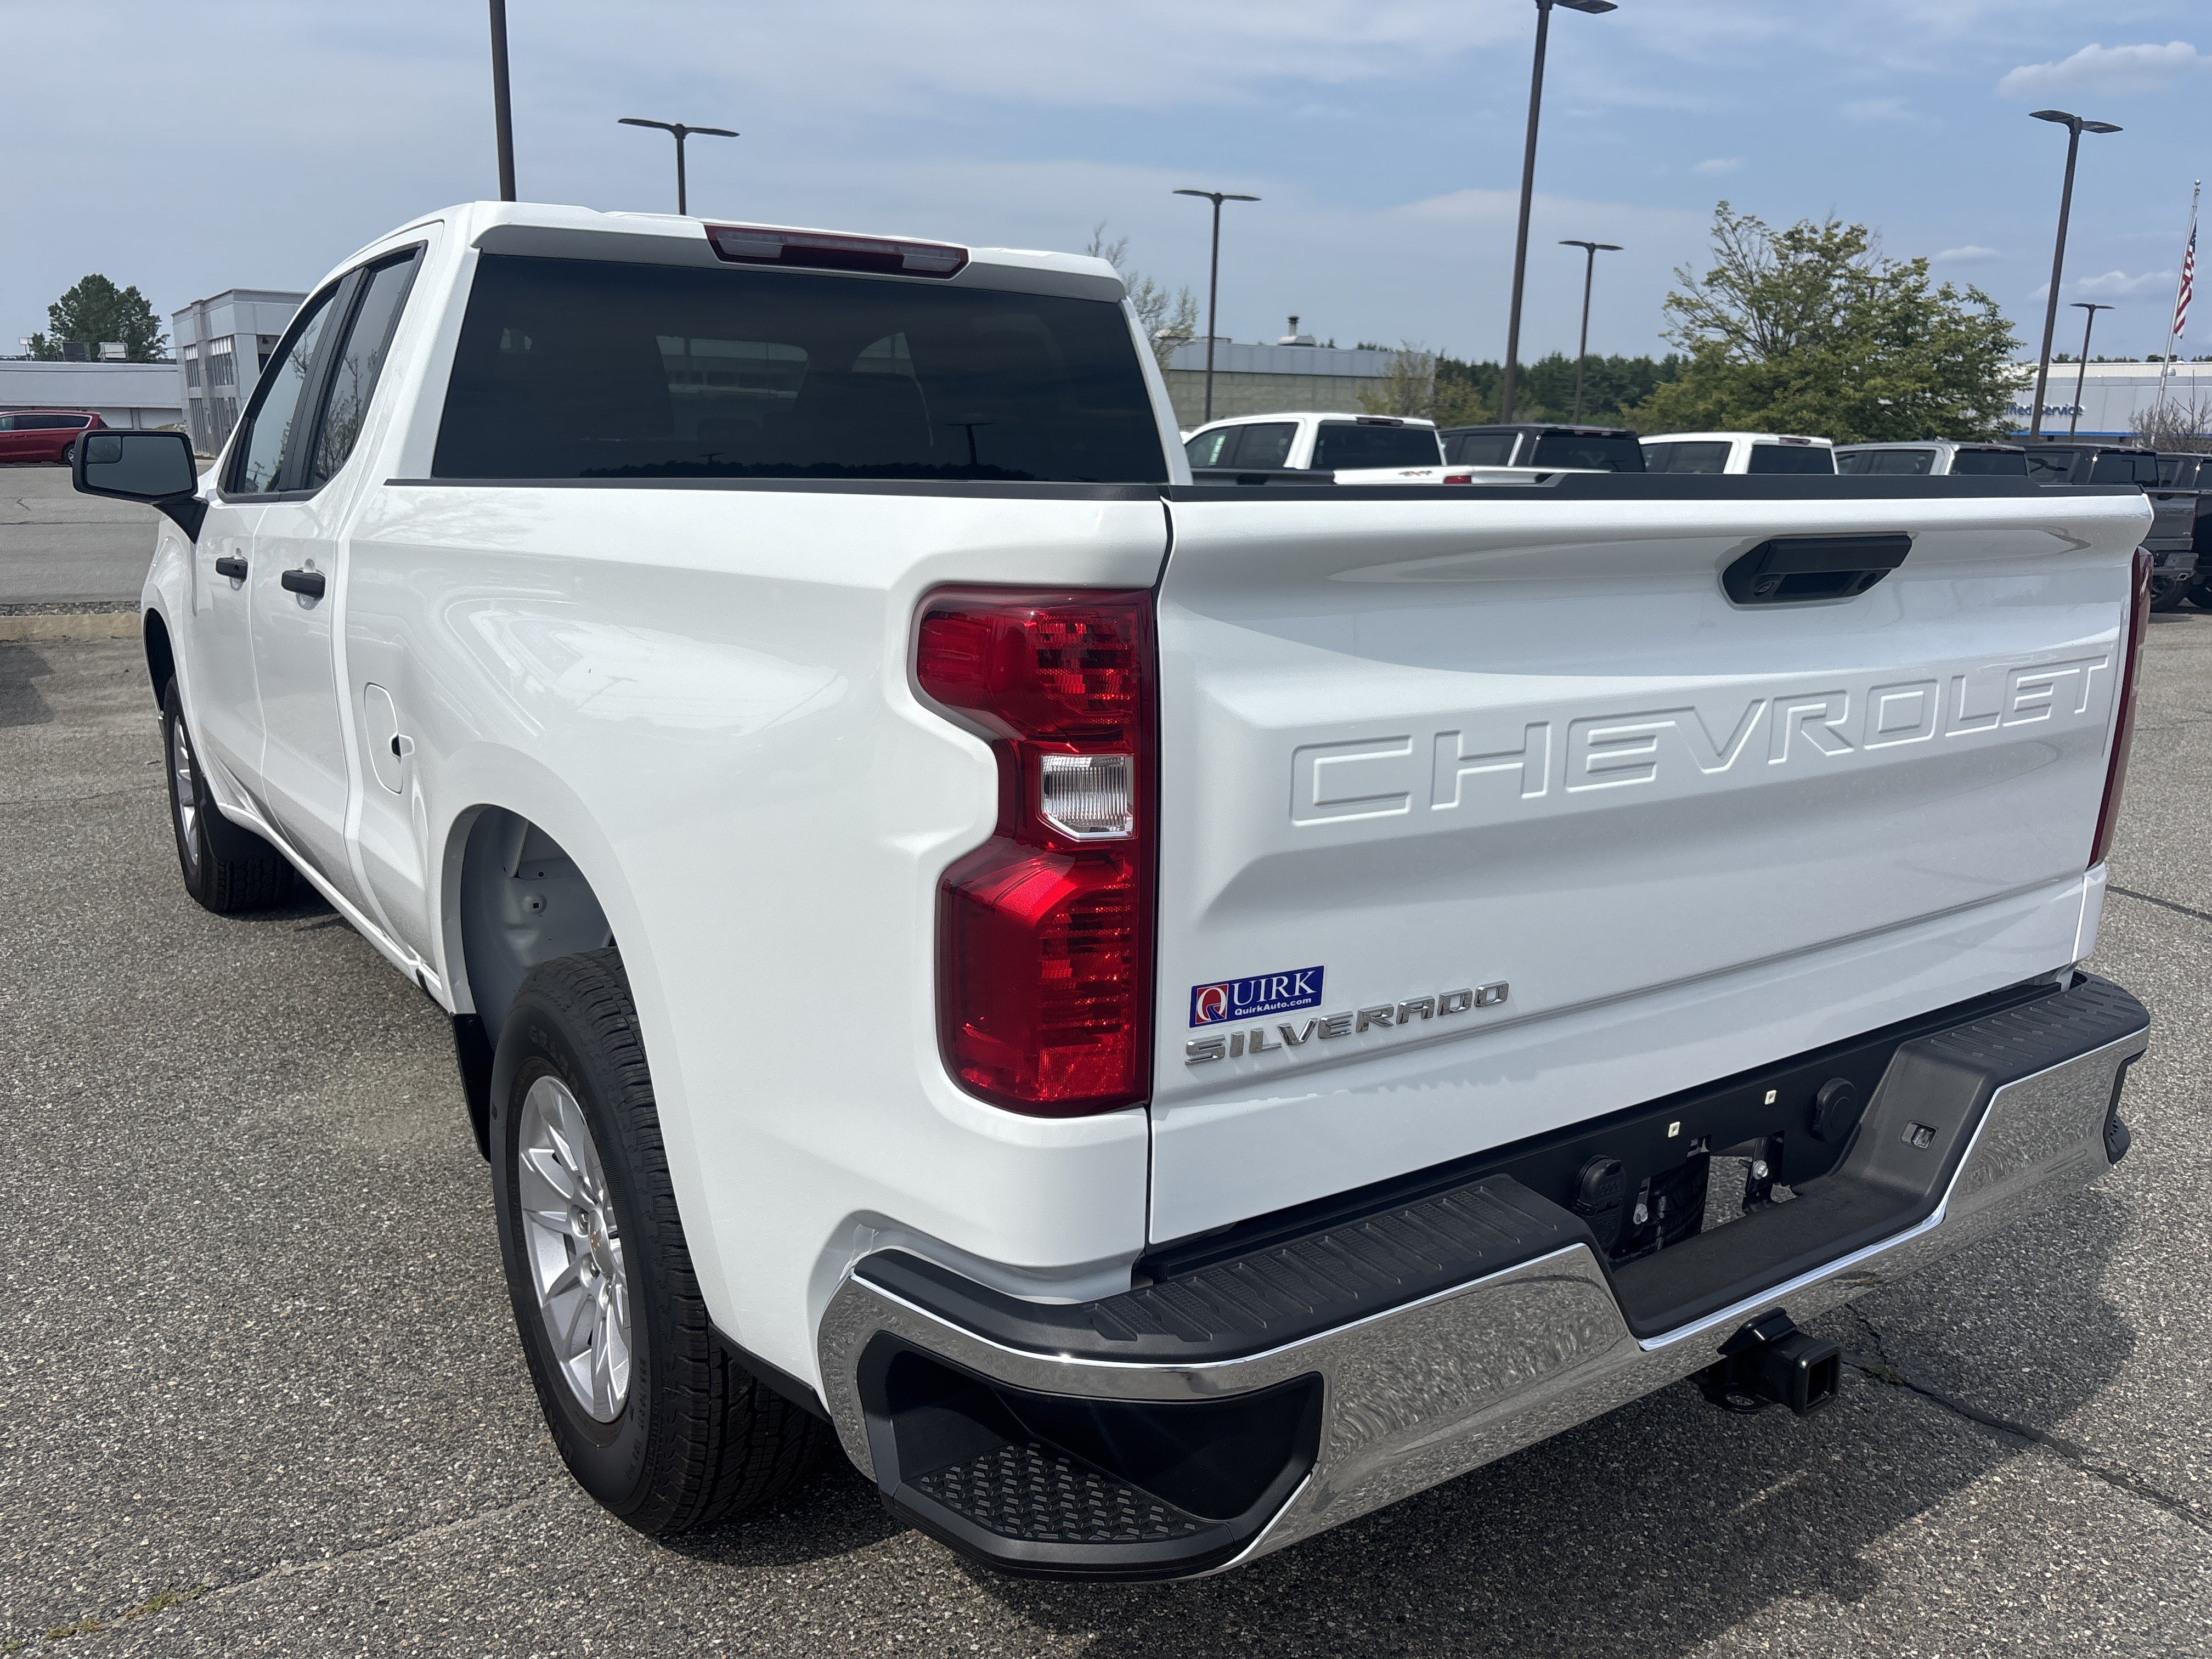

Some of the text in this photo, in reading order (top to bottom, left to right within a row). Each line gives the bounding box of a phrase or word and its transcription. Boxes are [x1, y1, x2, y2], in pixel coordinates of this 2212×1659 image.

[2042, 403, 2084, 415] ervice
[1290, 654, 2108, 827] CHEVROLET
[1196, 970, 1317, 1022] QUIRK
[1234, 997, 1312, 1016] QuirkAuto.com
[1184, 980, 1509, 1065] SILVERADO
